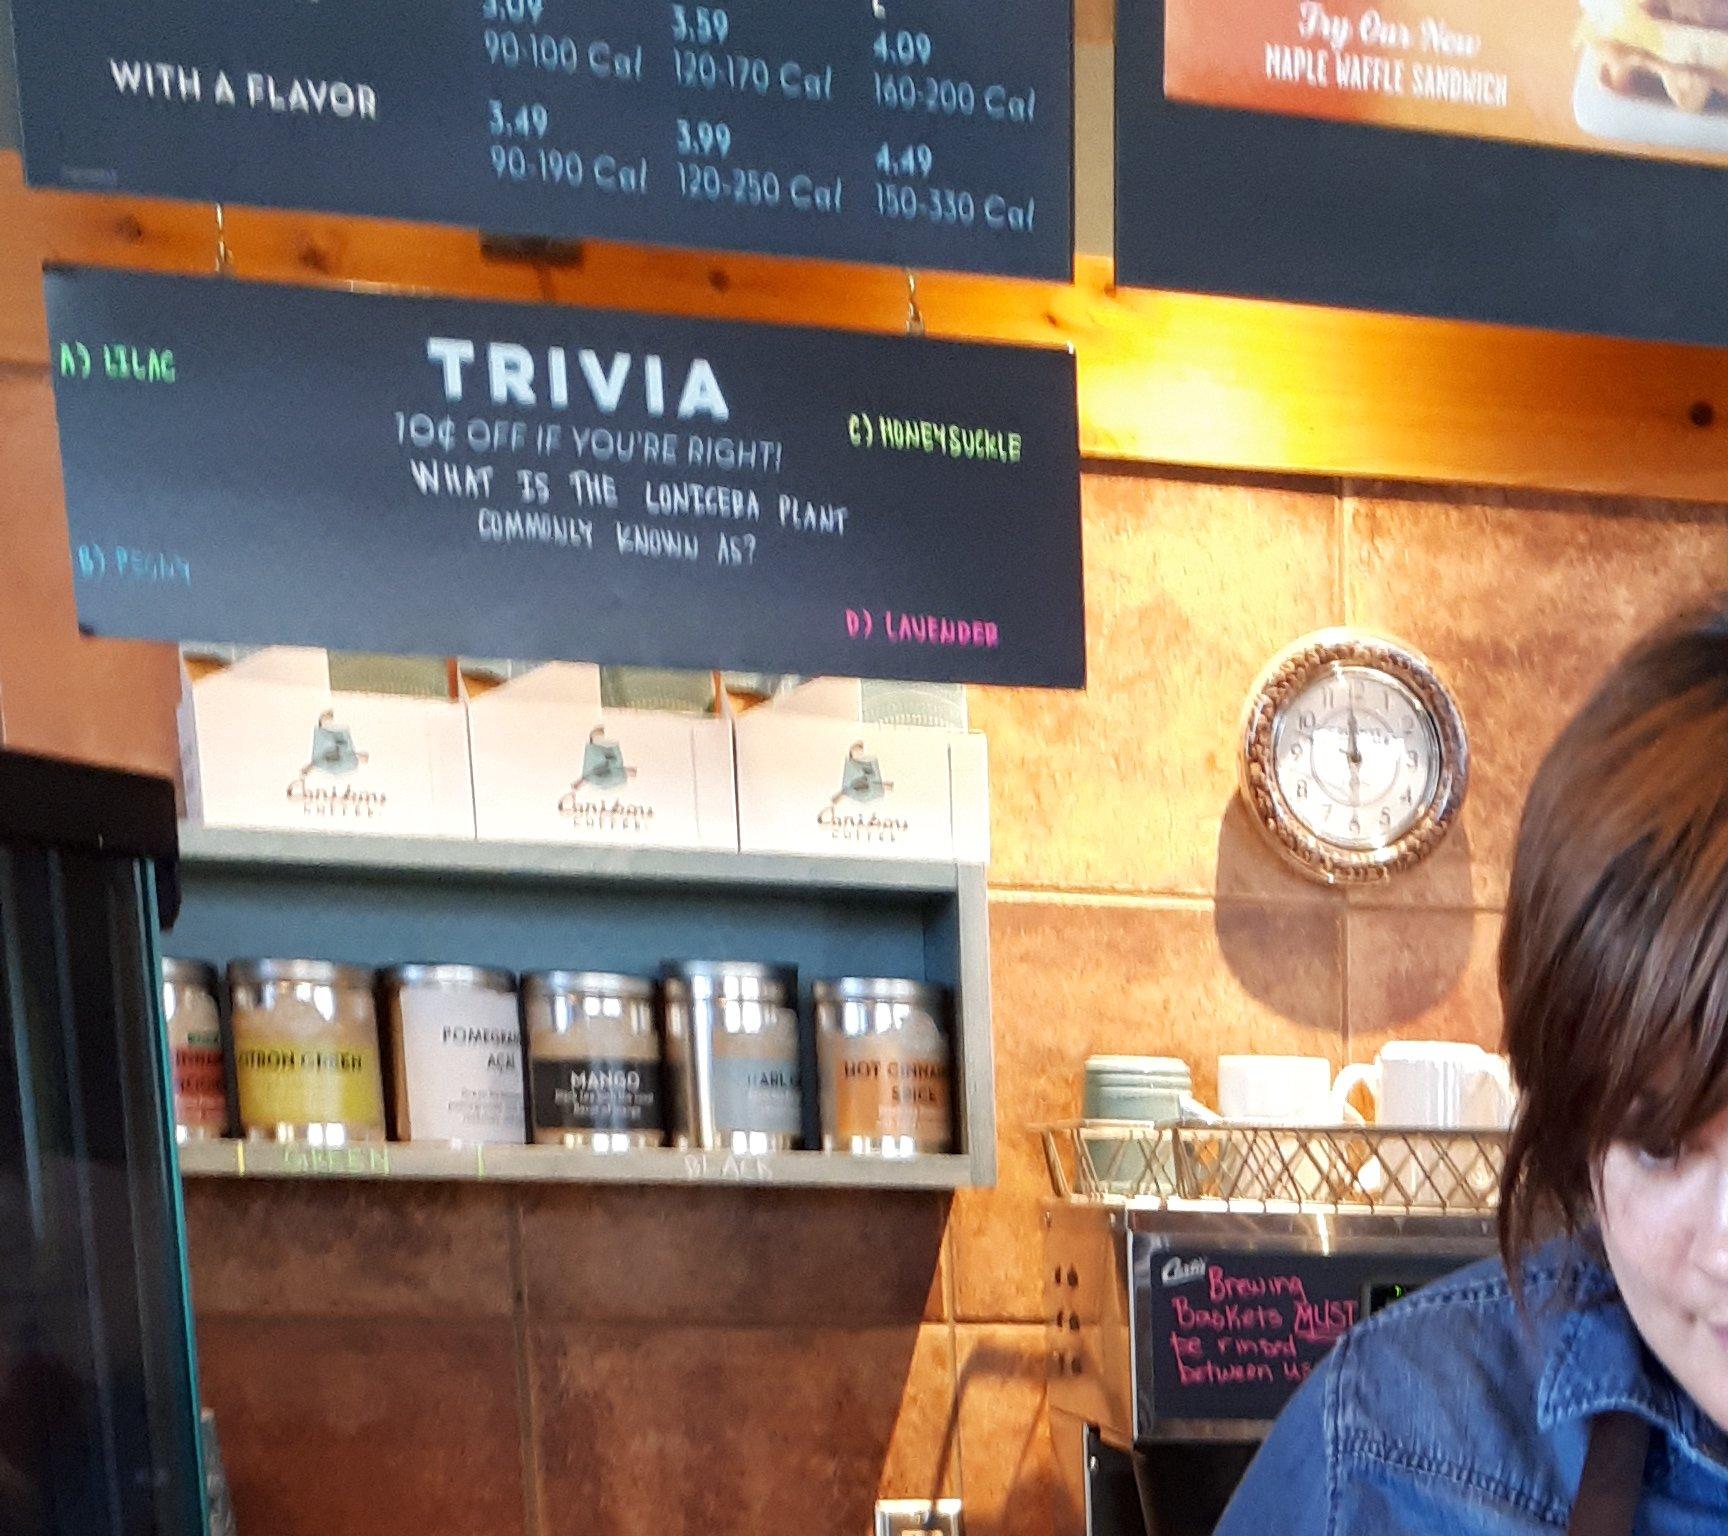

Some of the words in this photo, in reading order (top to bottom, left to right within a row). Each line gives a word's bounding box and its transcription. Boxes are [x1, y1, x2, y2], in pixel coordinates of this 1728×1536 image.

[484, 29, 579, 77] 90-100
[588, 40, 643, 82] Cal
[1264, 41, 1329, 88] MAPLE
[1335, 50, 1405, 95] WAFFLE
[1412, 62, 1509, 107] SANDWICH
[108, 57, 201, 101] WITH
[213, 69, 236, 107] A
[246, 71, 377, 121] FLAVOR
[780, 61, 832, 99] Cal
[984, 85, 1036, 124] Cal
[594, 154, 648, 195] Cal
[789, 173, 842, 214] Cal
[984, 193, 1035, 233] Cal
[426, 335, 730, 424] TRIVIA
[466, 417, 528, 453] OFF
[536, 422, 563, 458] IF
[571, 425, 679, 468] YOU'RE
[687, 434, 784, 474] RIGHT!
[878, 415, 1023, 464] HONEYSUCKLE
[409, 456, 495, 501] WHAT
[516, 467, 551, 506] IS
[568, 467, 619, 509] THE
[778, 493, 849, 537] PLANT
[476, 506, 594, 552] COMMONLY
[615, 519, 701, 562] KNOWN
[716, 530, 758, 569] AS?
[884, 610, 1000, 649] LAVENDER
[570, 1067, 641, 1094] MANGO
[844, 1059, 881, 1079] HOT
[1293, 1298, 1360, 1340] MUST
